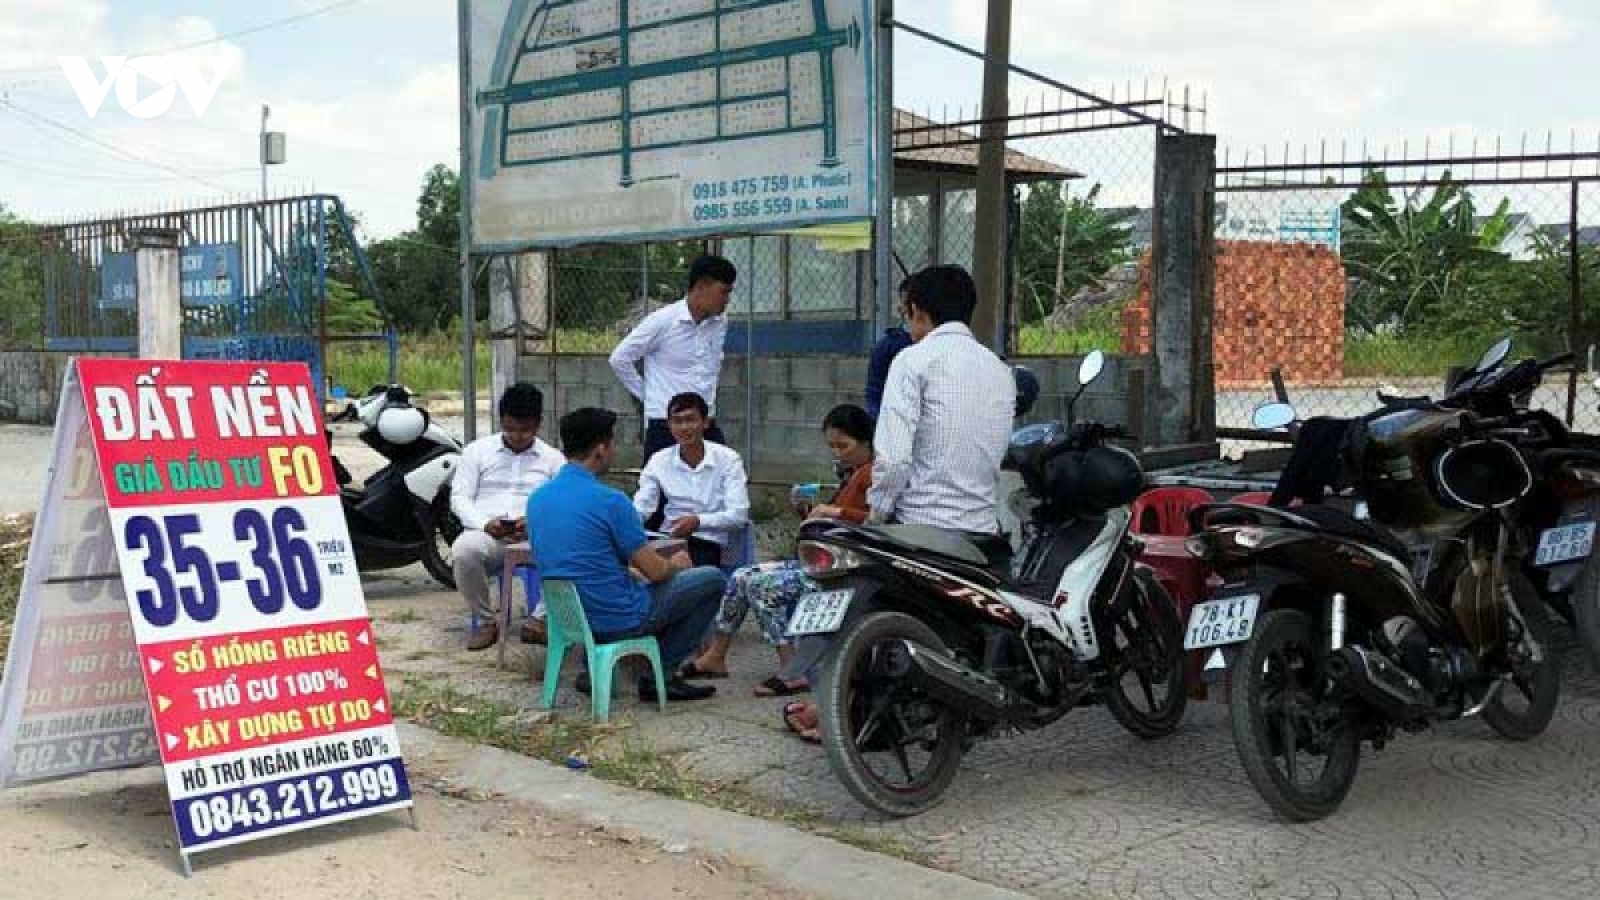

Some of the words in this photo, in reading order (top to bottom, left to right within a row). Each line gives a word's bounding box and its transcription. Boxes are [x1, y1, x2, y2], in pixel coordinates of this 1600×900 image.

[732, 178, 757, 196] 475
[761, 174, 789, 193] 759
[692, 202, 728, 221] 0985
[732, 199, 759, 217] 556
[763, 196, 792, 214] 559
[94, 367, 197, 441] ĐẤT
[209, 368, 317, 437] NỀN
[227, 455, 264, 487] TƯ
[124, 505, 323, 627] 35-36
[283, 630, 350, 659] RIÊNG
[246, 675, 281, 703] CƯ
[285, 668, 348, 697] 100%
[184, 718, 231, 751] XÂY
[238, 707, 303, 742] DỰNG
[307, 703, 336, 732] TỰ
[341, 699, 371, 722] DO
[212, 758, 245, 786] TRỢ
[250, 748, 300, 779] NGÂN
[303, 740, 349, 769] HÀNG
[352, 734, 389, 758] 60%
[188, 764, 400, 838] 0843.212.999
